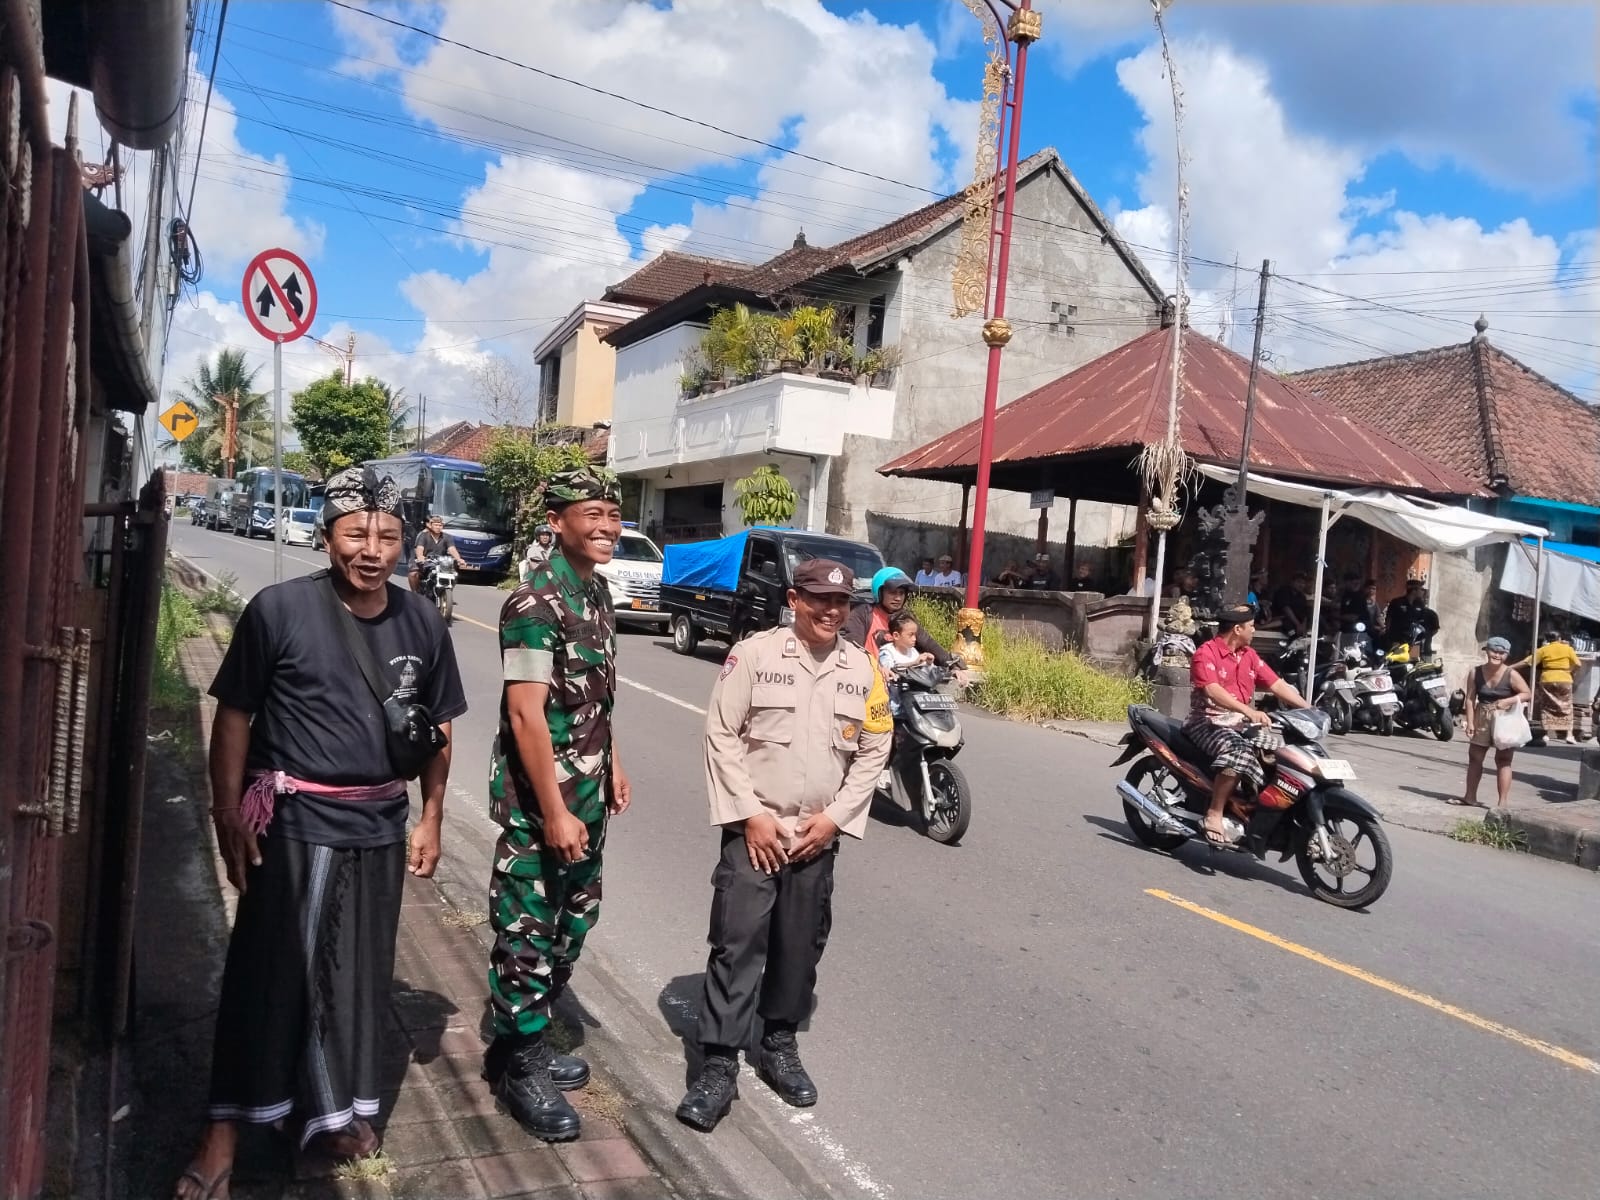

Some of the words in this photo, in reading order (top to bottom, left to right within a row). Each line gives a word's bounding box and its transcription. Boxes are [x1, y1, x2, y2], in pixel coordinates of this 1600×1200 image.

[617, 569, 643, 580] POLISI
[756, 671, 795, 685] YUDIS
[1277, 779, 1300, 797] YAMAHA
